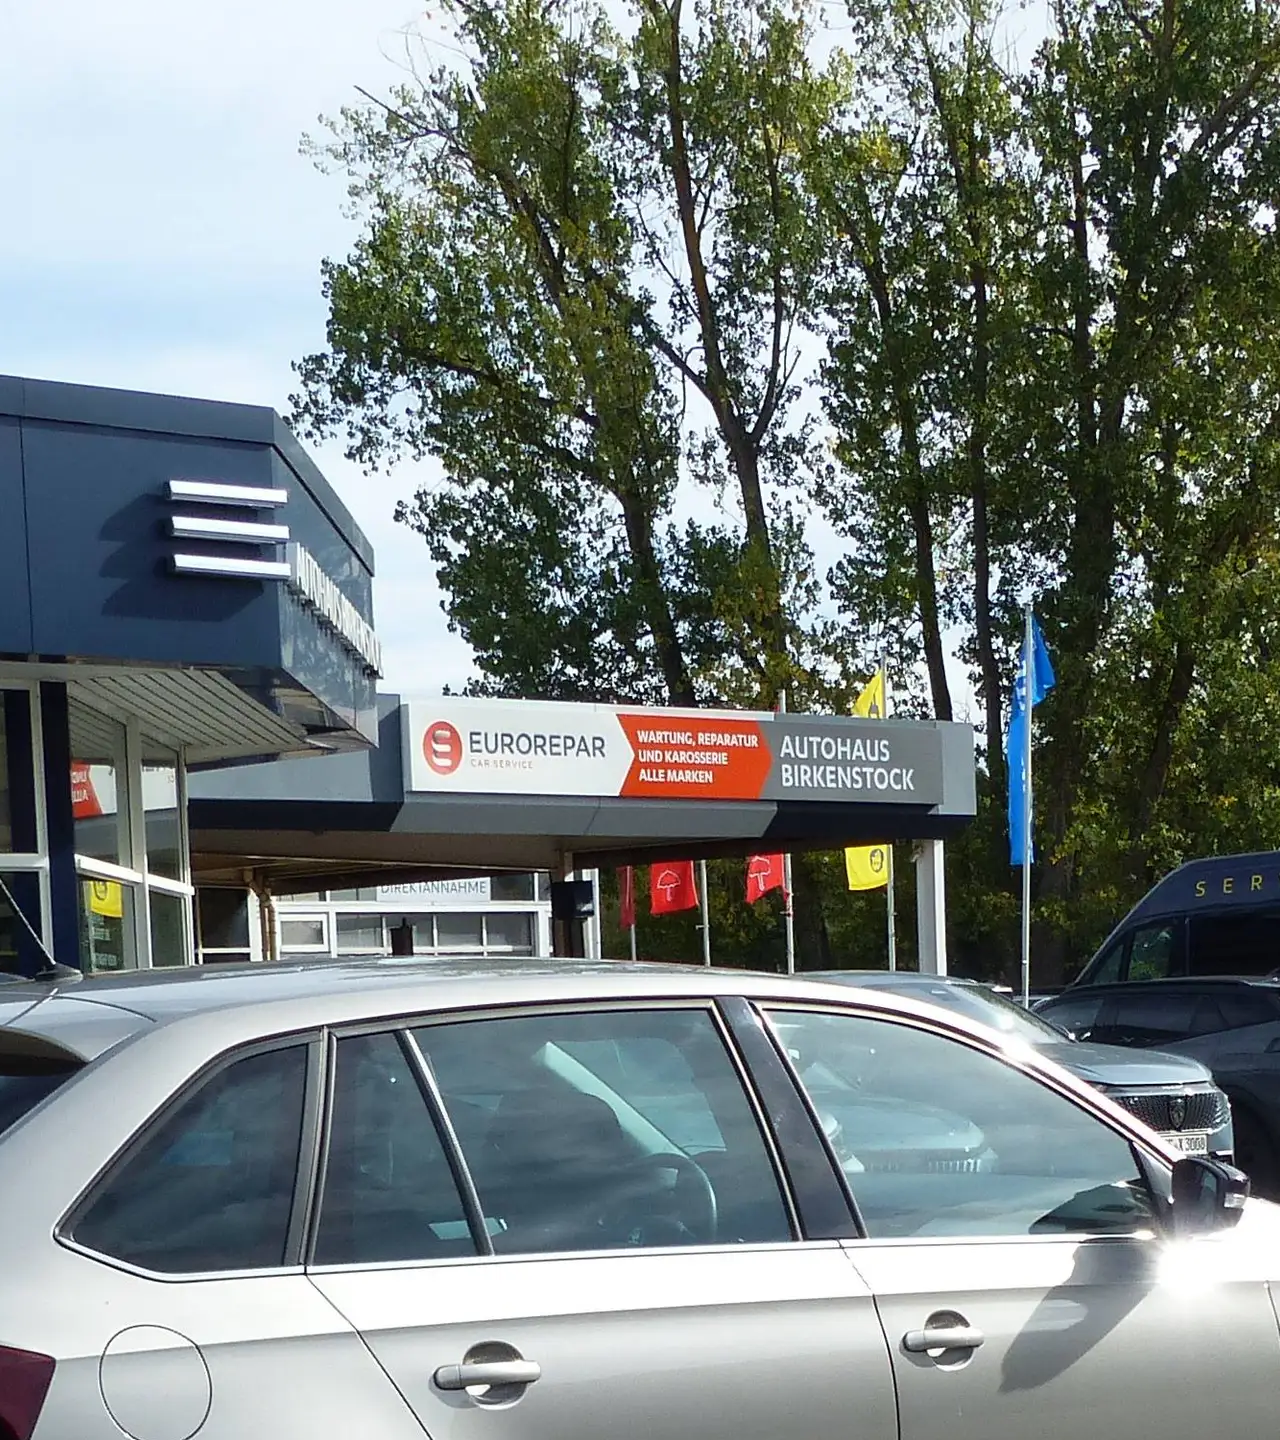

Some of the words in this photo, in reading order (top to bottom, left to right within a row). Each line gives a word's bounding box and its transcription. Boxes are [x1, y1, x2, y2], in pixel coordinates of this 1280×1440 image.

[469, 731, 606, 758] EUROREPAR
[637, 730, 696, 747] WARTUNG,
[697, 732, 758, 748] REPARATUR
[638, 749, 663, 763] UND
[665, 750, 728, 765] KAROSSERIE
[780, 735, 890, 762] AUTOHAUS
[470, 758, 489, 768] CAR
[492, 760, 533, 769] SERVICE
[639, 768, 665, 782] ALLE
[667, 769, 713, 784] MARKEN
[781, 764, 915, 791] BIRKENSTOCK
[381, 881, 487, 894] DIREKTANNAHME
